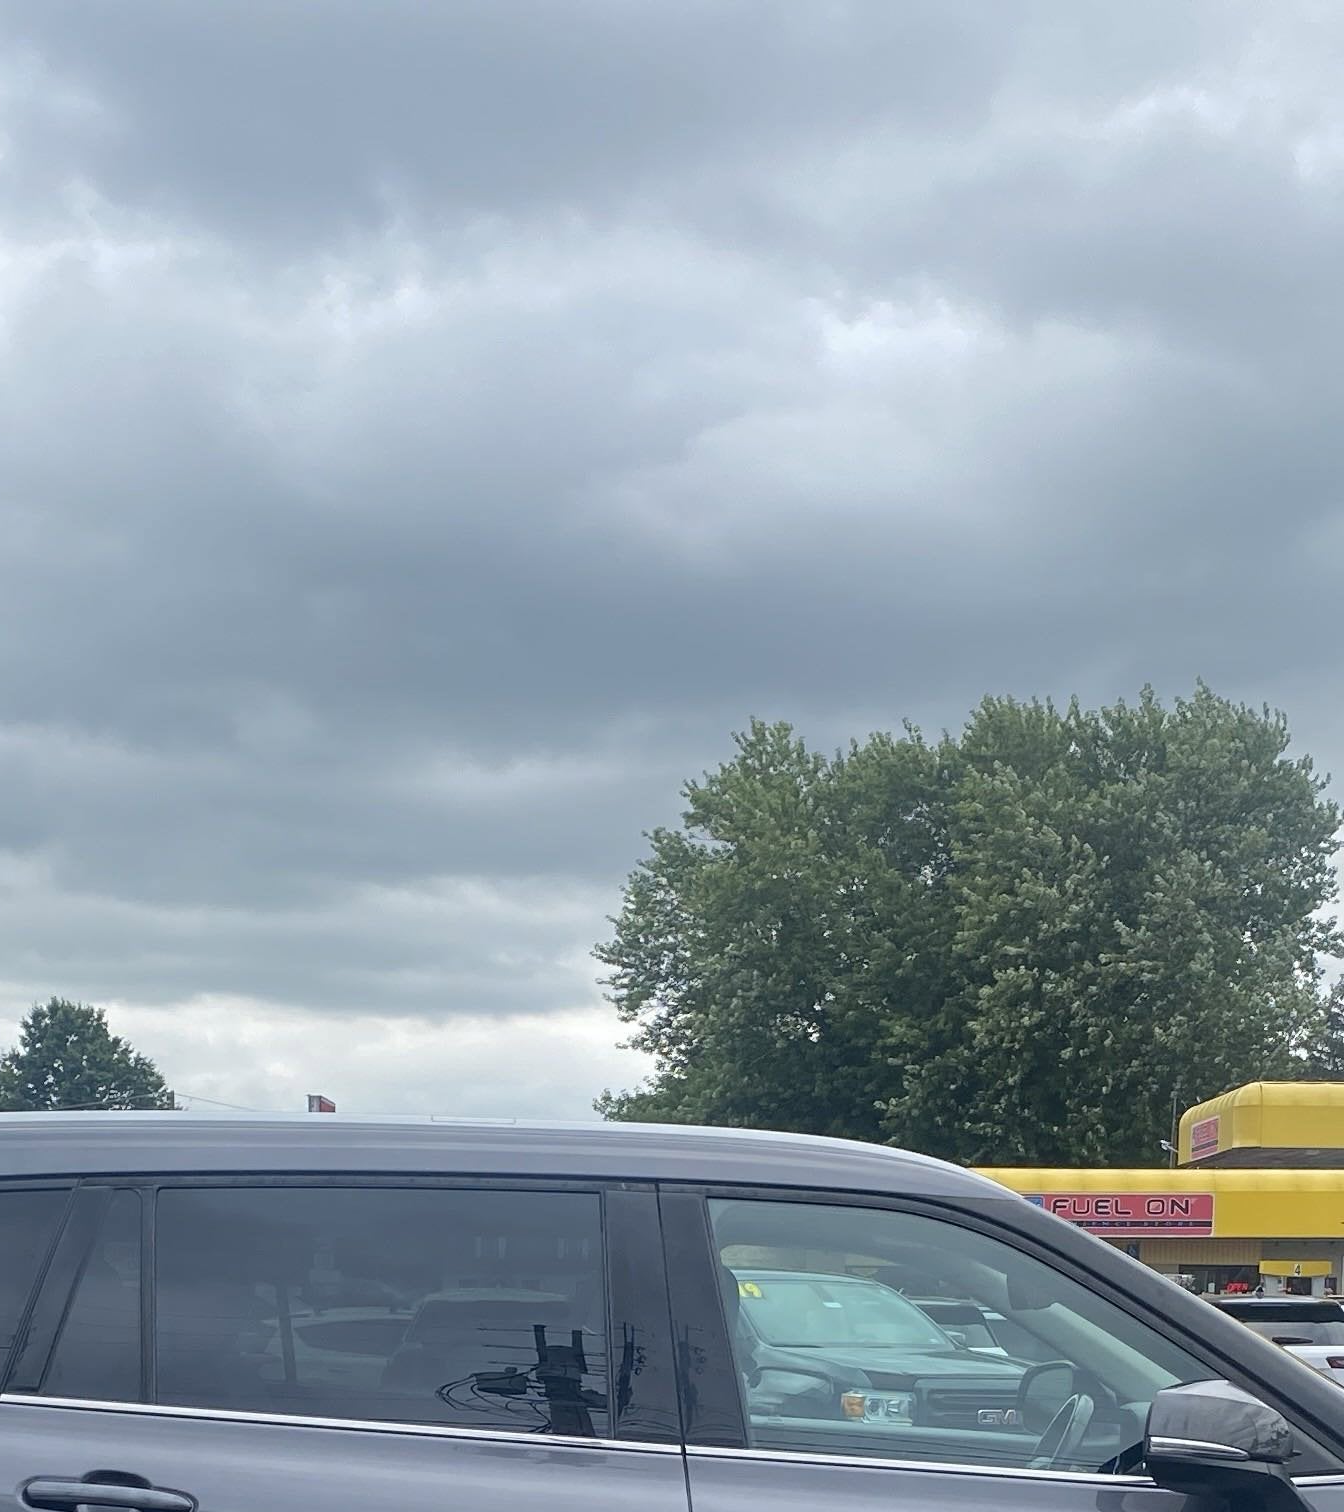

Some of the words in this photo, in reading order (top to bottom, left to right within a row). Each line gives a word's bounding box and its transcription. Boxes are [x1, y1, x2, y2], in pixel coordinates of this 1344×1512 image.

[1051, 1197, 1132, 1217] FUEL
[1146, 1197, 1192, 1217] ON
[1293, 1263, 1302, 1276] 4
[1225, 1282, 1249, 1292] OPEN
[977, 1408, 1022, 1425] GM
